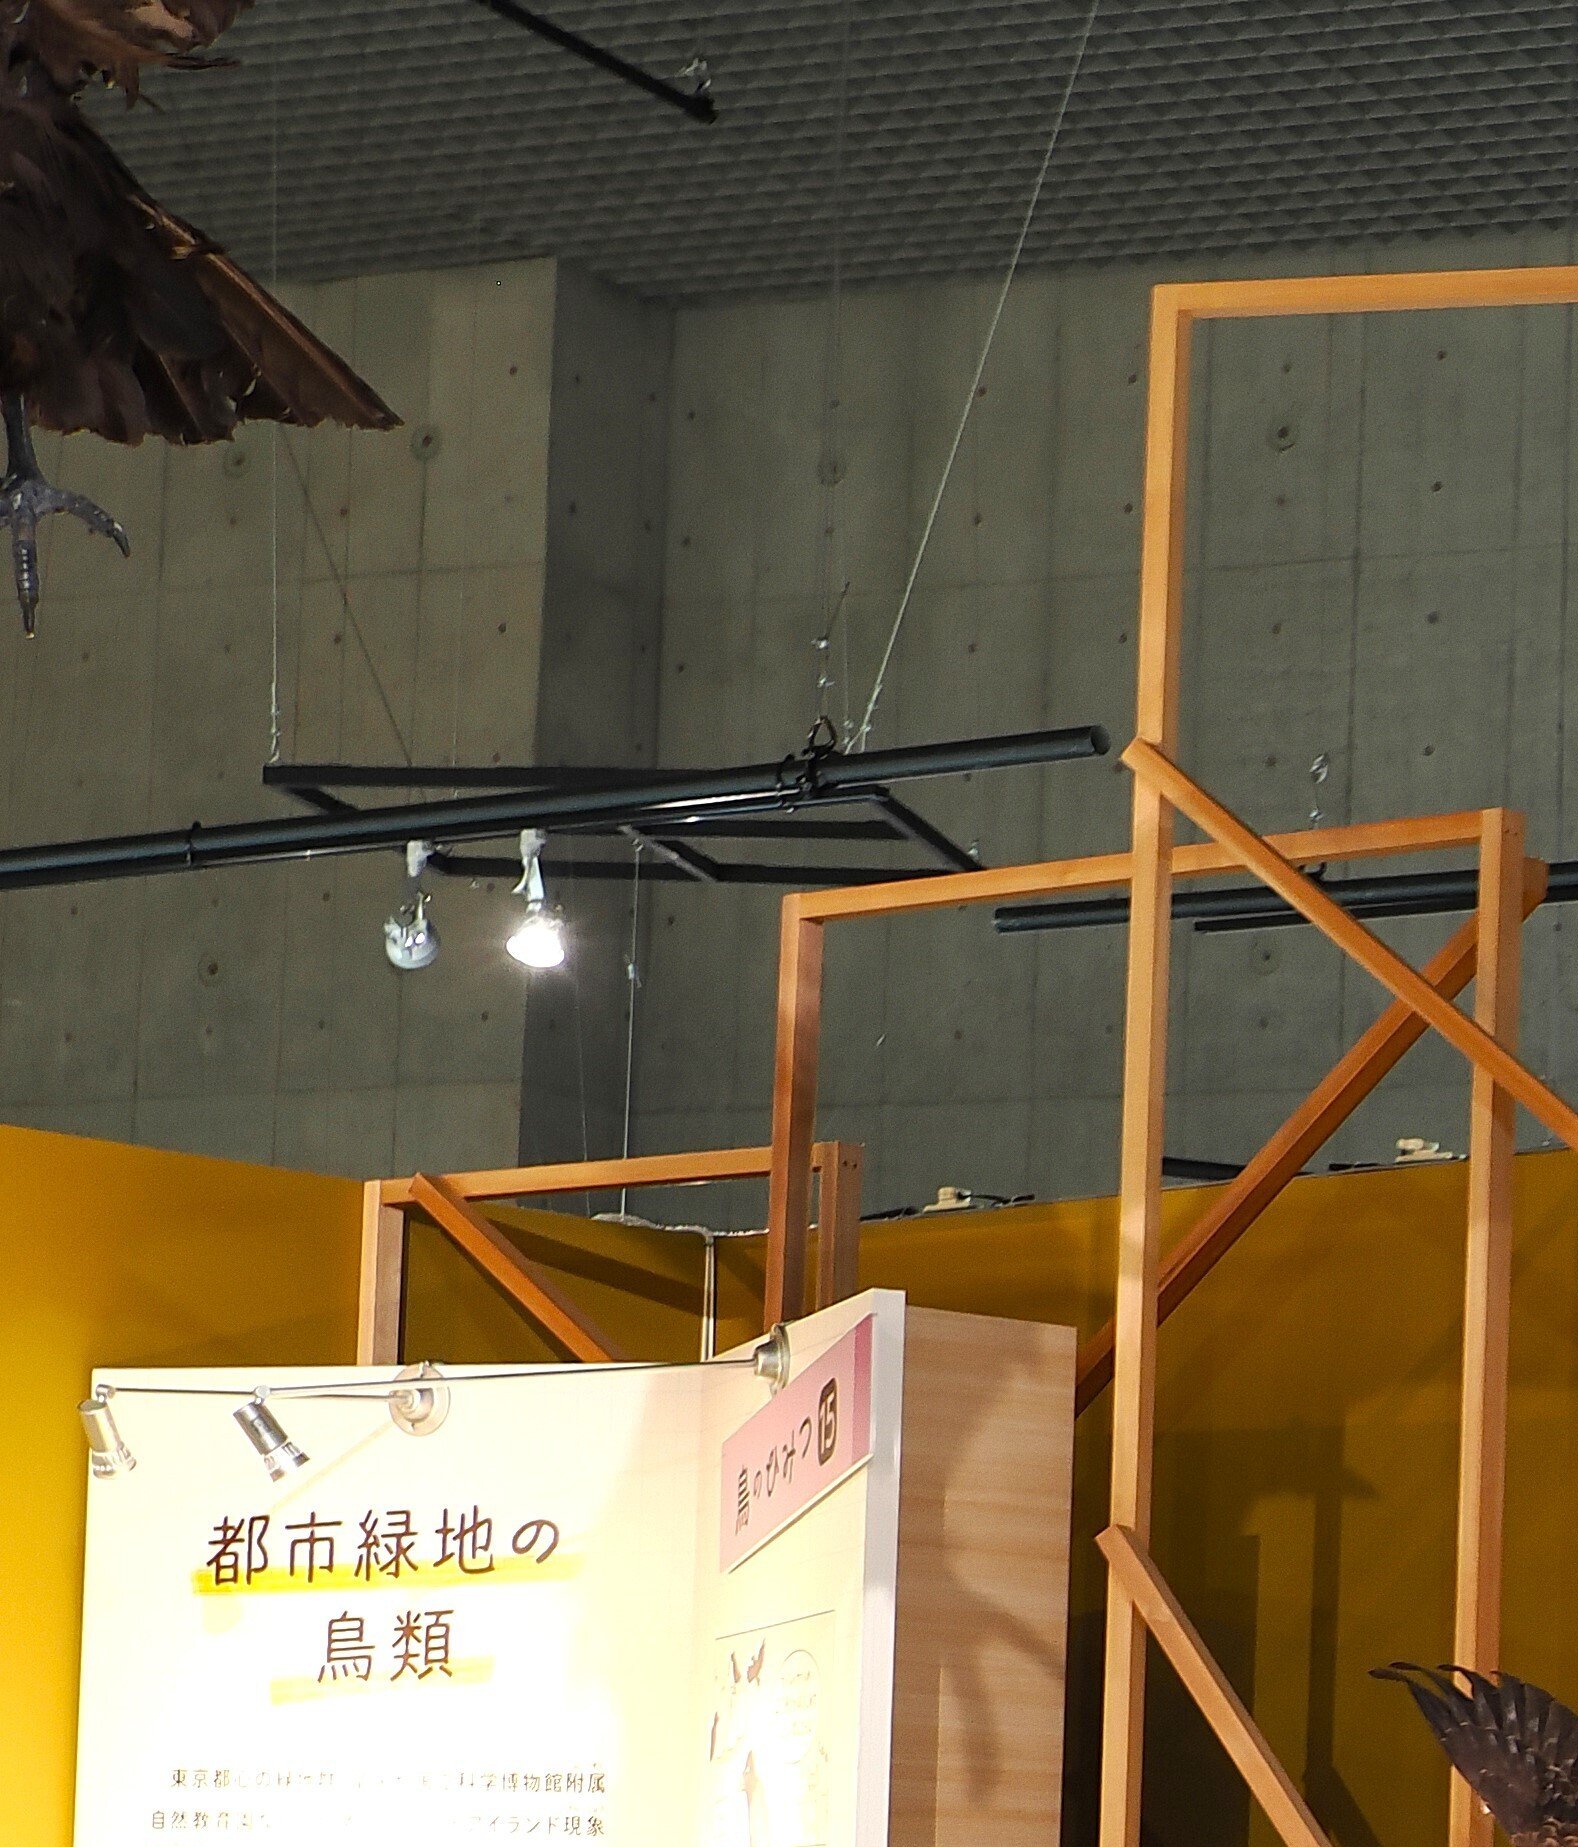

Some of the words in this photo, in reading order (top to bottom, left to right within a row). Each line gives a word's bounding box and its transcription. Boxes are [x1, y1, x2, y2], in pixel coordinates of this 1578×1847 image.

[735, 1415, 812, 1535] 鳥のひみつ
[818, 1391, 836, 1453] 15
[206, 1504, 561, 1586] 都市緑地の
[316, 1608, 455, 1683] 鳥類
